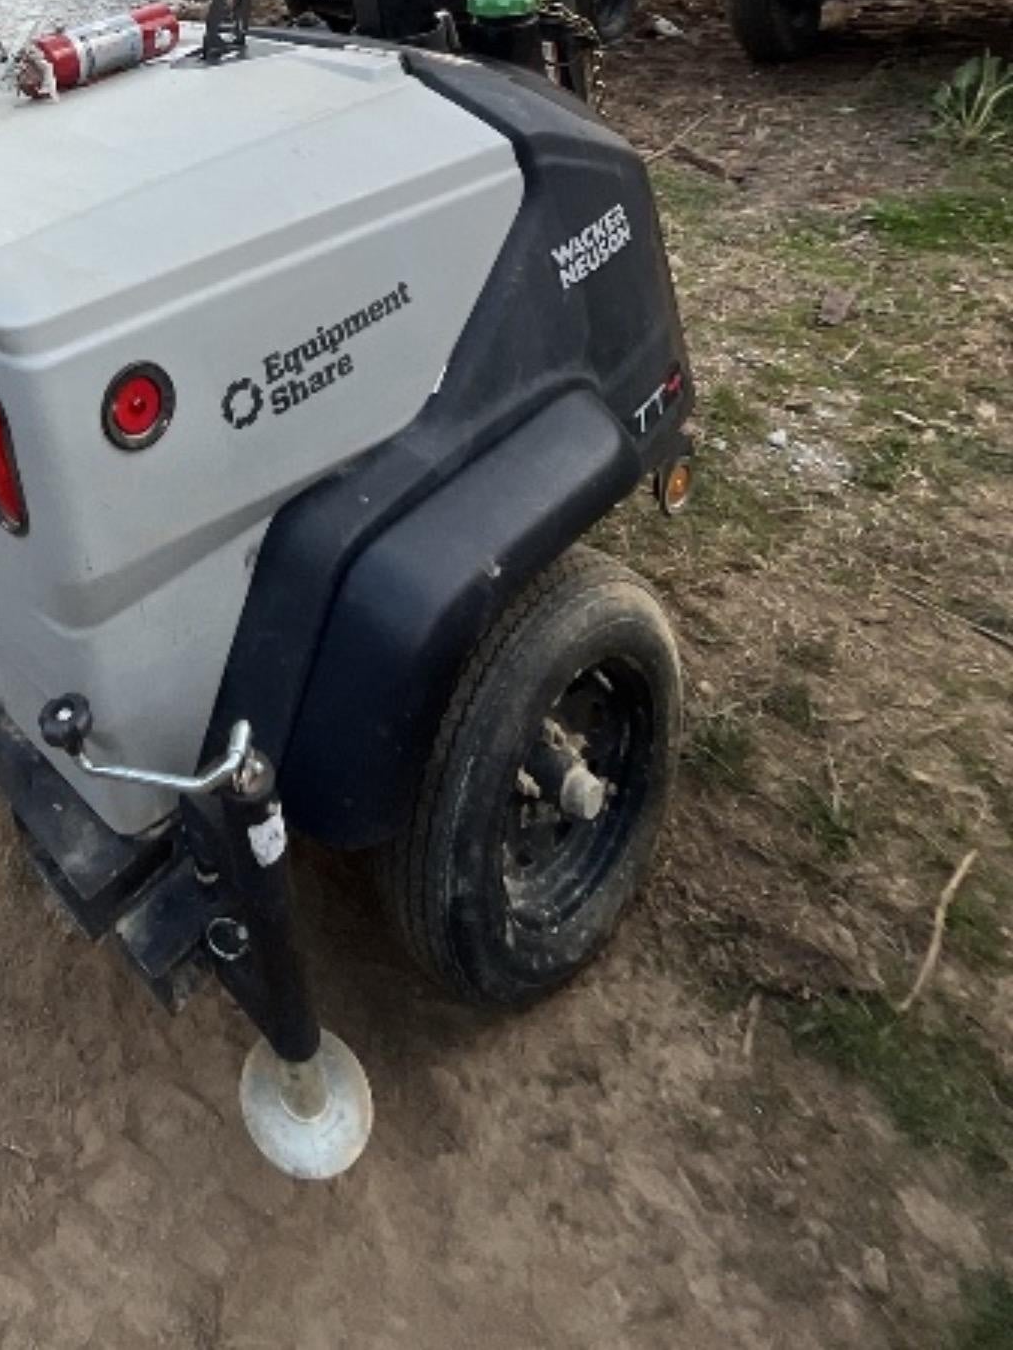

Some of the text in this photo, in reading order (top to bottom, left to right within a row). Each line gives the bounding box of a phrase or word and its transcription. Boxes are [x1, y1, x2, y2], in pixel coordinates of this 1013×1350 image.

[550, 202, 628, 268] WACKER
[559, 219, 633, 290] NEUSON
[262, 281, 413, 385] Equipment
[269, 353, 355, 416] Share
[633, 372, 682, 434] TT
